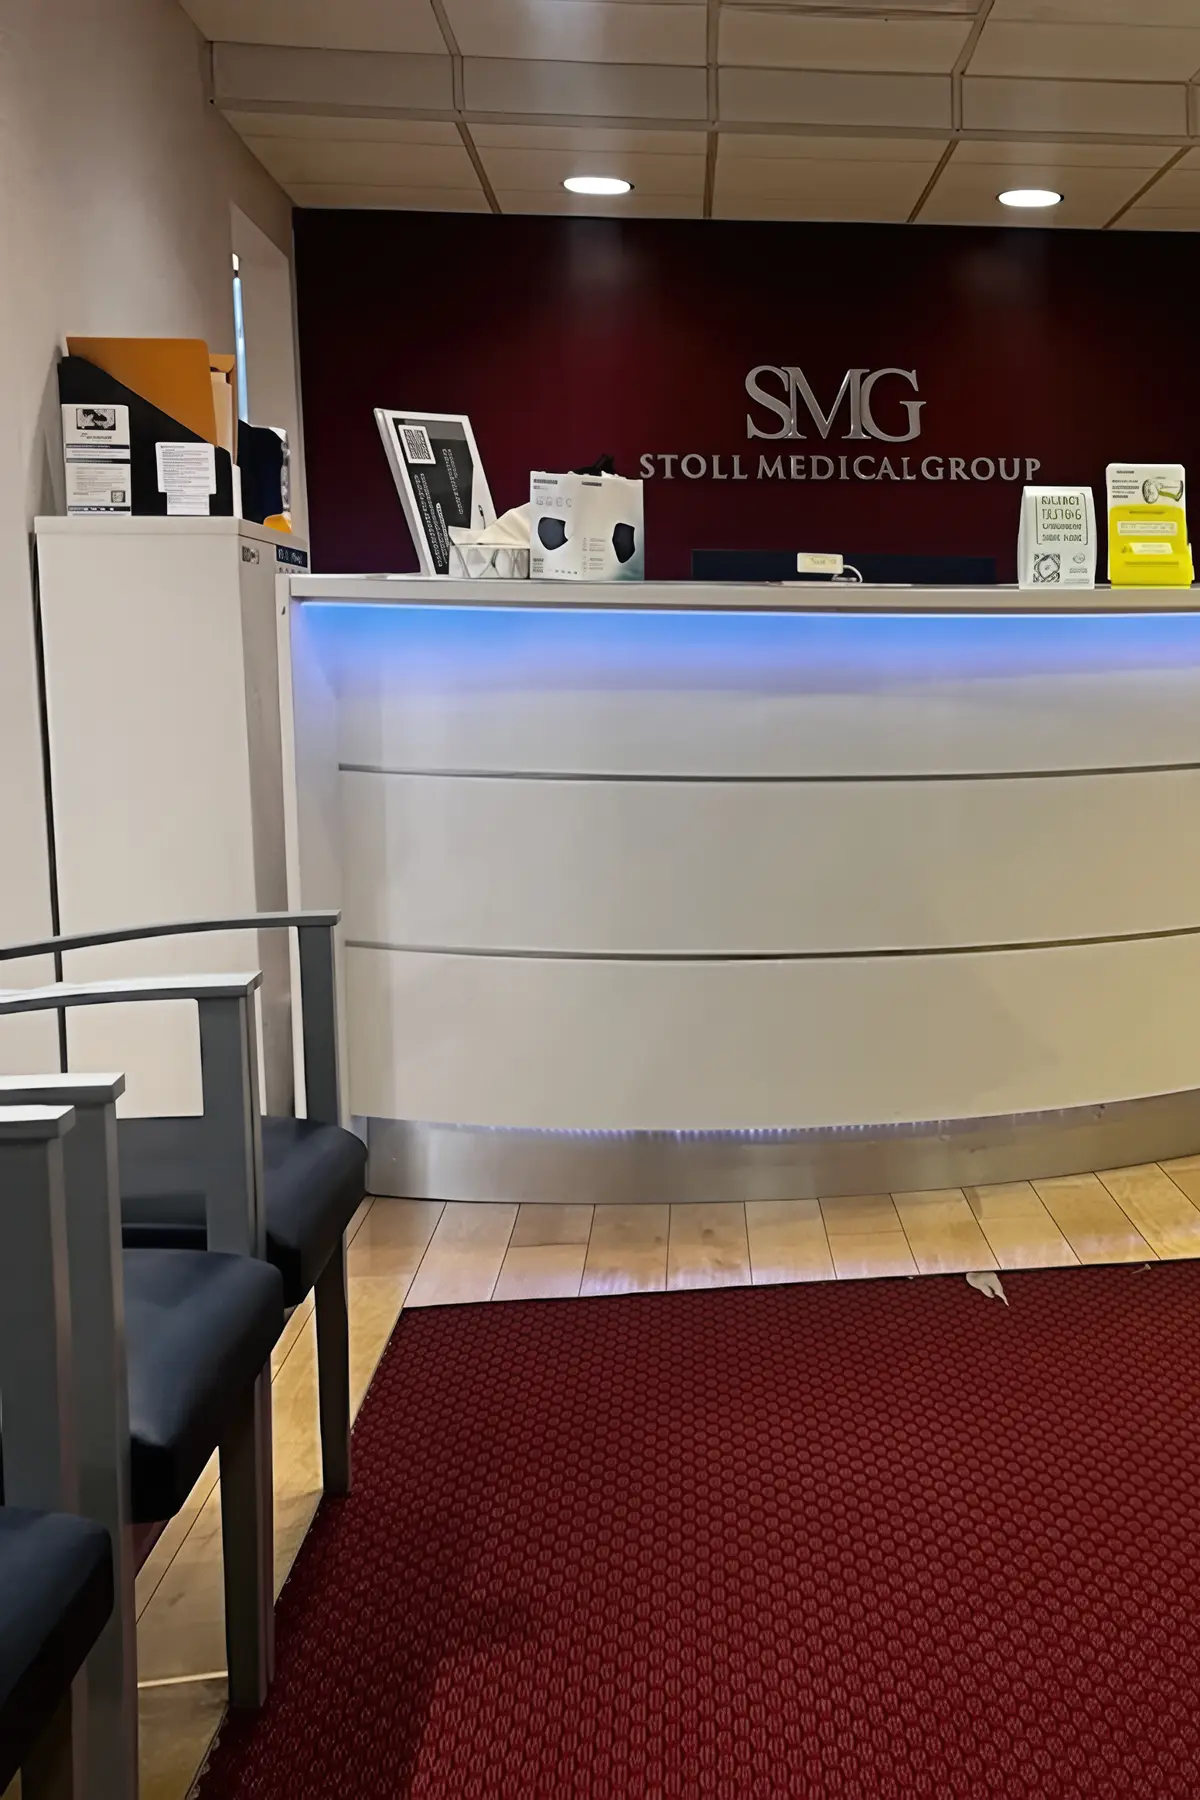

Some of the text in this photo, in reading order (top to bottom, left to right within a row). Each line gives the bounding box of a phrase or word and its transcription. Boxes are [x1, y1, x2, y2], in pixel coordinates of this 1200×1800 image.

[744, 365, 927, 443] SMG
[639, 453, 1041, 482] STOLL MEDICAL GROUP
